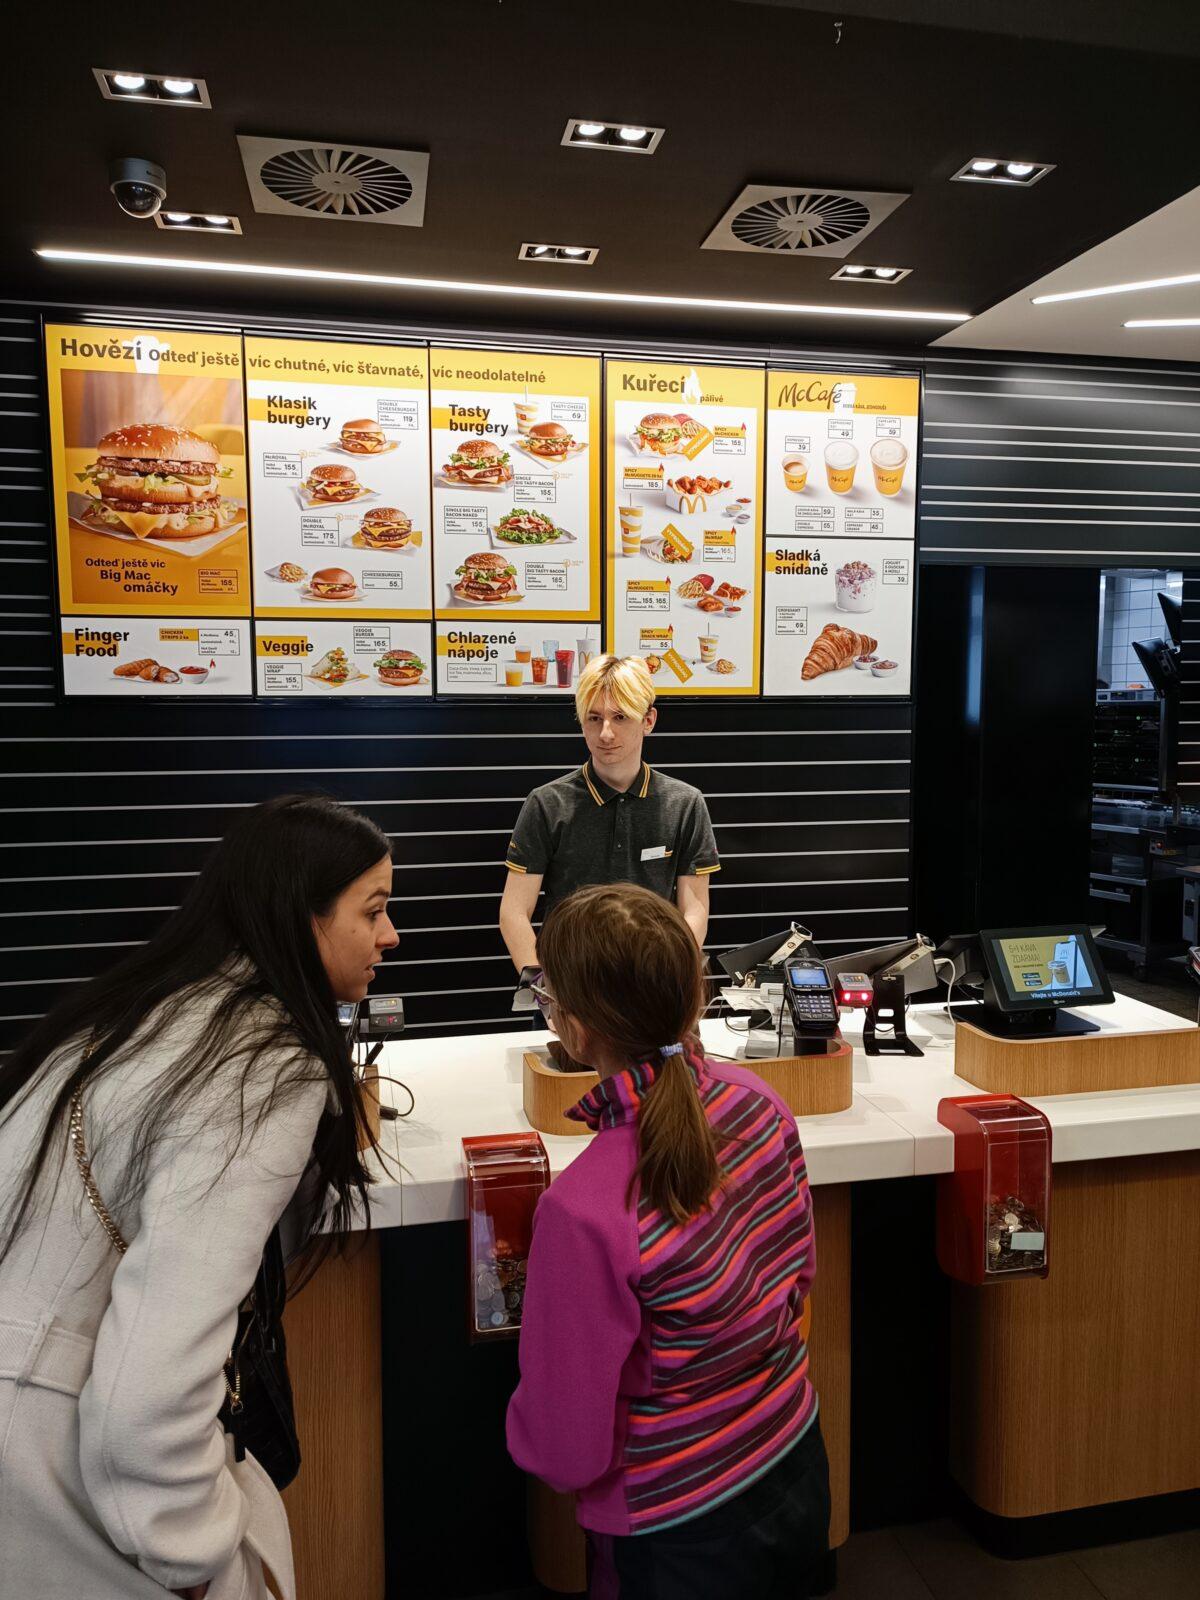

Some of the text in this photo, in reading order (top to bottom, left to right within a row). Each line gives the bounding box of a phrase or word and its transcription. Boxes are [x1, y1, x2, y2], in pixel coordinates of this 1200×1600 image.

[60, 338, 142, 361] Hovězí
[200, 352, 240, 368] ještě
[249, 354, 424, 380] víc chutné, víc šťavnaté,
[431, 365, 546, 383] víc neodolatelné
[622, 373, 686, 394] Kuřecí
[267, 395, 318, 410] Klasik
[700, 394, 724, 403] pálivé
[778, 381, 843, 410] McCafé
[267, 410, 331, 430] burgery
[449, 404, 491, 421] Tasty
[449, 419, 509, 437] burgery
[775, 548, 821, 562] Sladká
[85, 558, 120, 567] Odteď
[121, 559, 148, 570] ještě
[775, 562, 829, 576] snídaně
[100, 570, 151, 582] Big Mac
[123, 581, 179, 596] omáčky
[74, 627, 129, 645] Finger
[447, 631, 517, 644] Chlazené
[75, 644, 118, 657] Food
[262, 639, 314, 656] Veggie
[447, 645, 499, 661] nápoje
